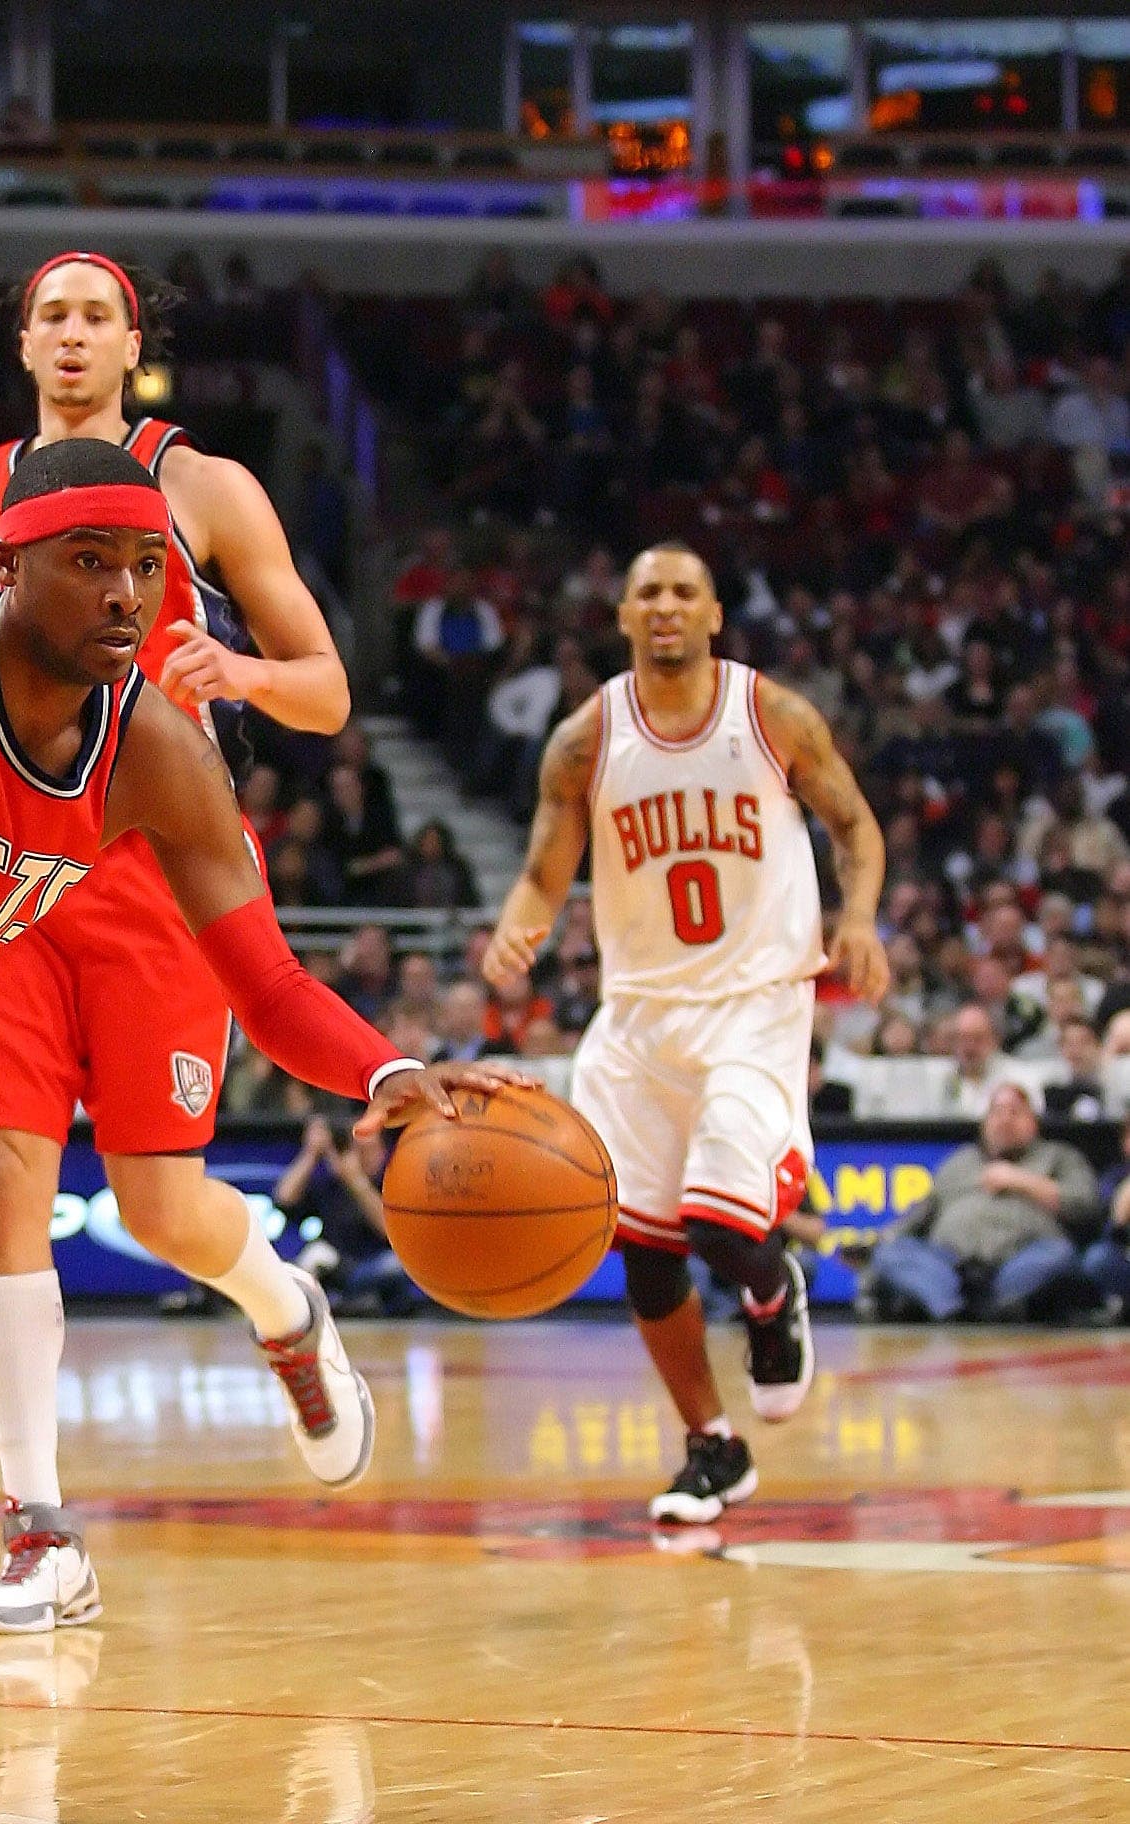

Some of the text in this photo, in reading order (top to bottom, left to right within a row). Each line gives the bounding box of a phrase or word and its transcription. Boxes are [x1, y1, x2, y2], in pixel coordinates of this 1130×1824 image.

[610, 787, 763, 874] BULLS
[666, 858, 726, 945] 0
[807, 1163, 933, 1214] AMP
